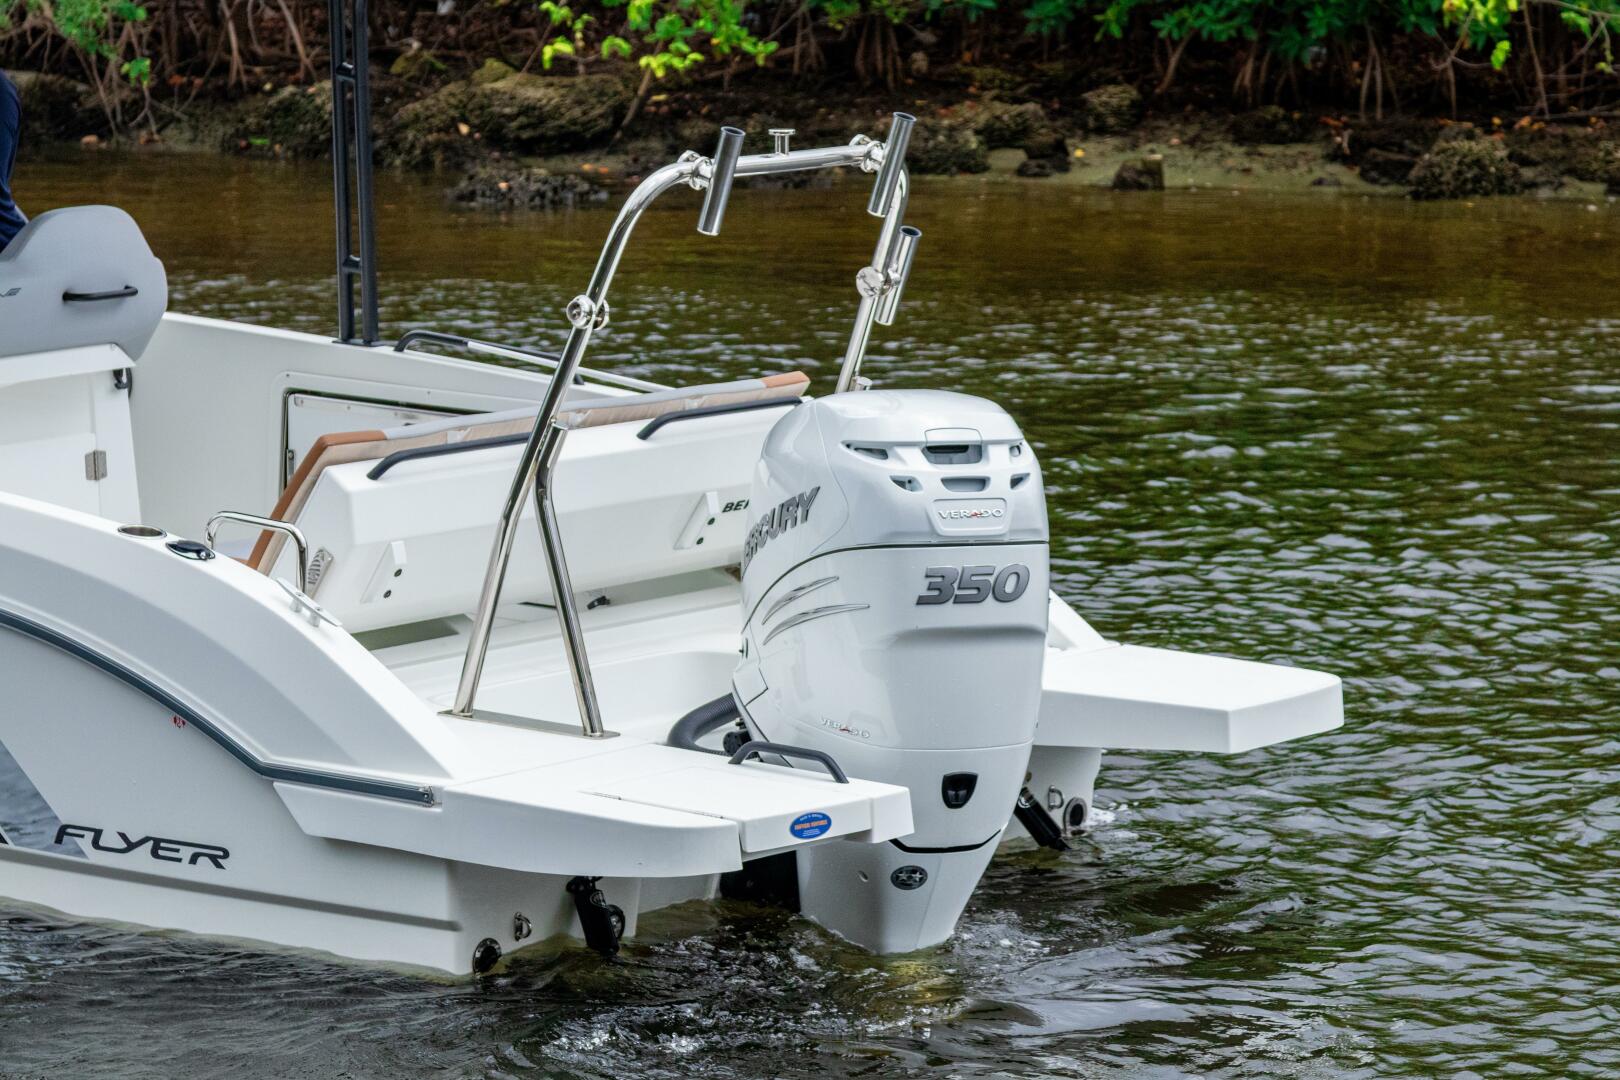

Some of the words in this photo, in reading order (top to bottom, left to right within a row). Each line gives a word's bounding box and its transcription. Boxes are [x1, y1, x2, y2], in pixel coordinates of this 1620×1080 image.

[742, 486, 821, 571] ERCURY
[938, 508, 1004, 519] VERADO
[915, 563, 1031, 605] 350
[54, 823, 230, 870] FLYER
